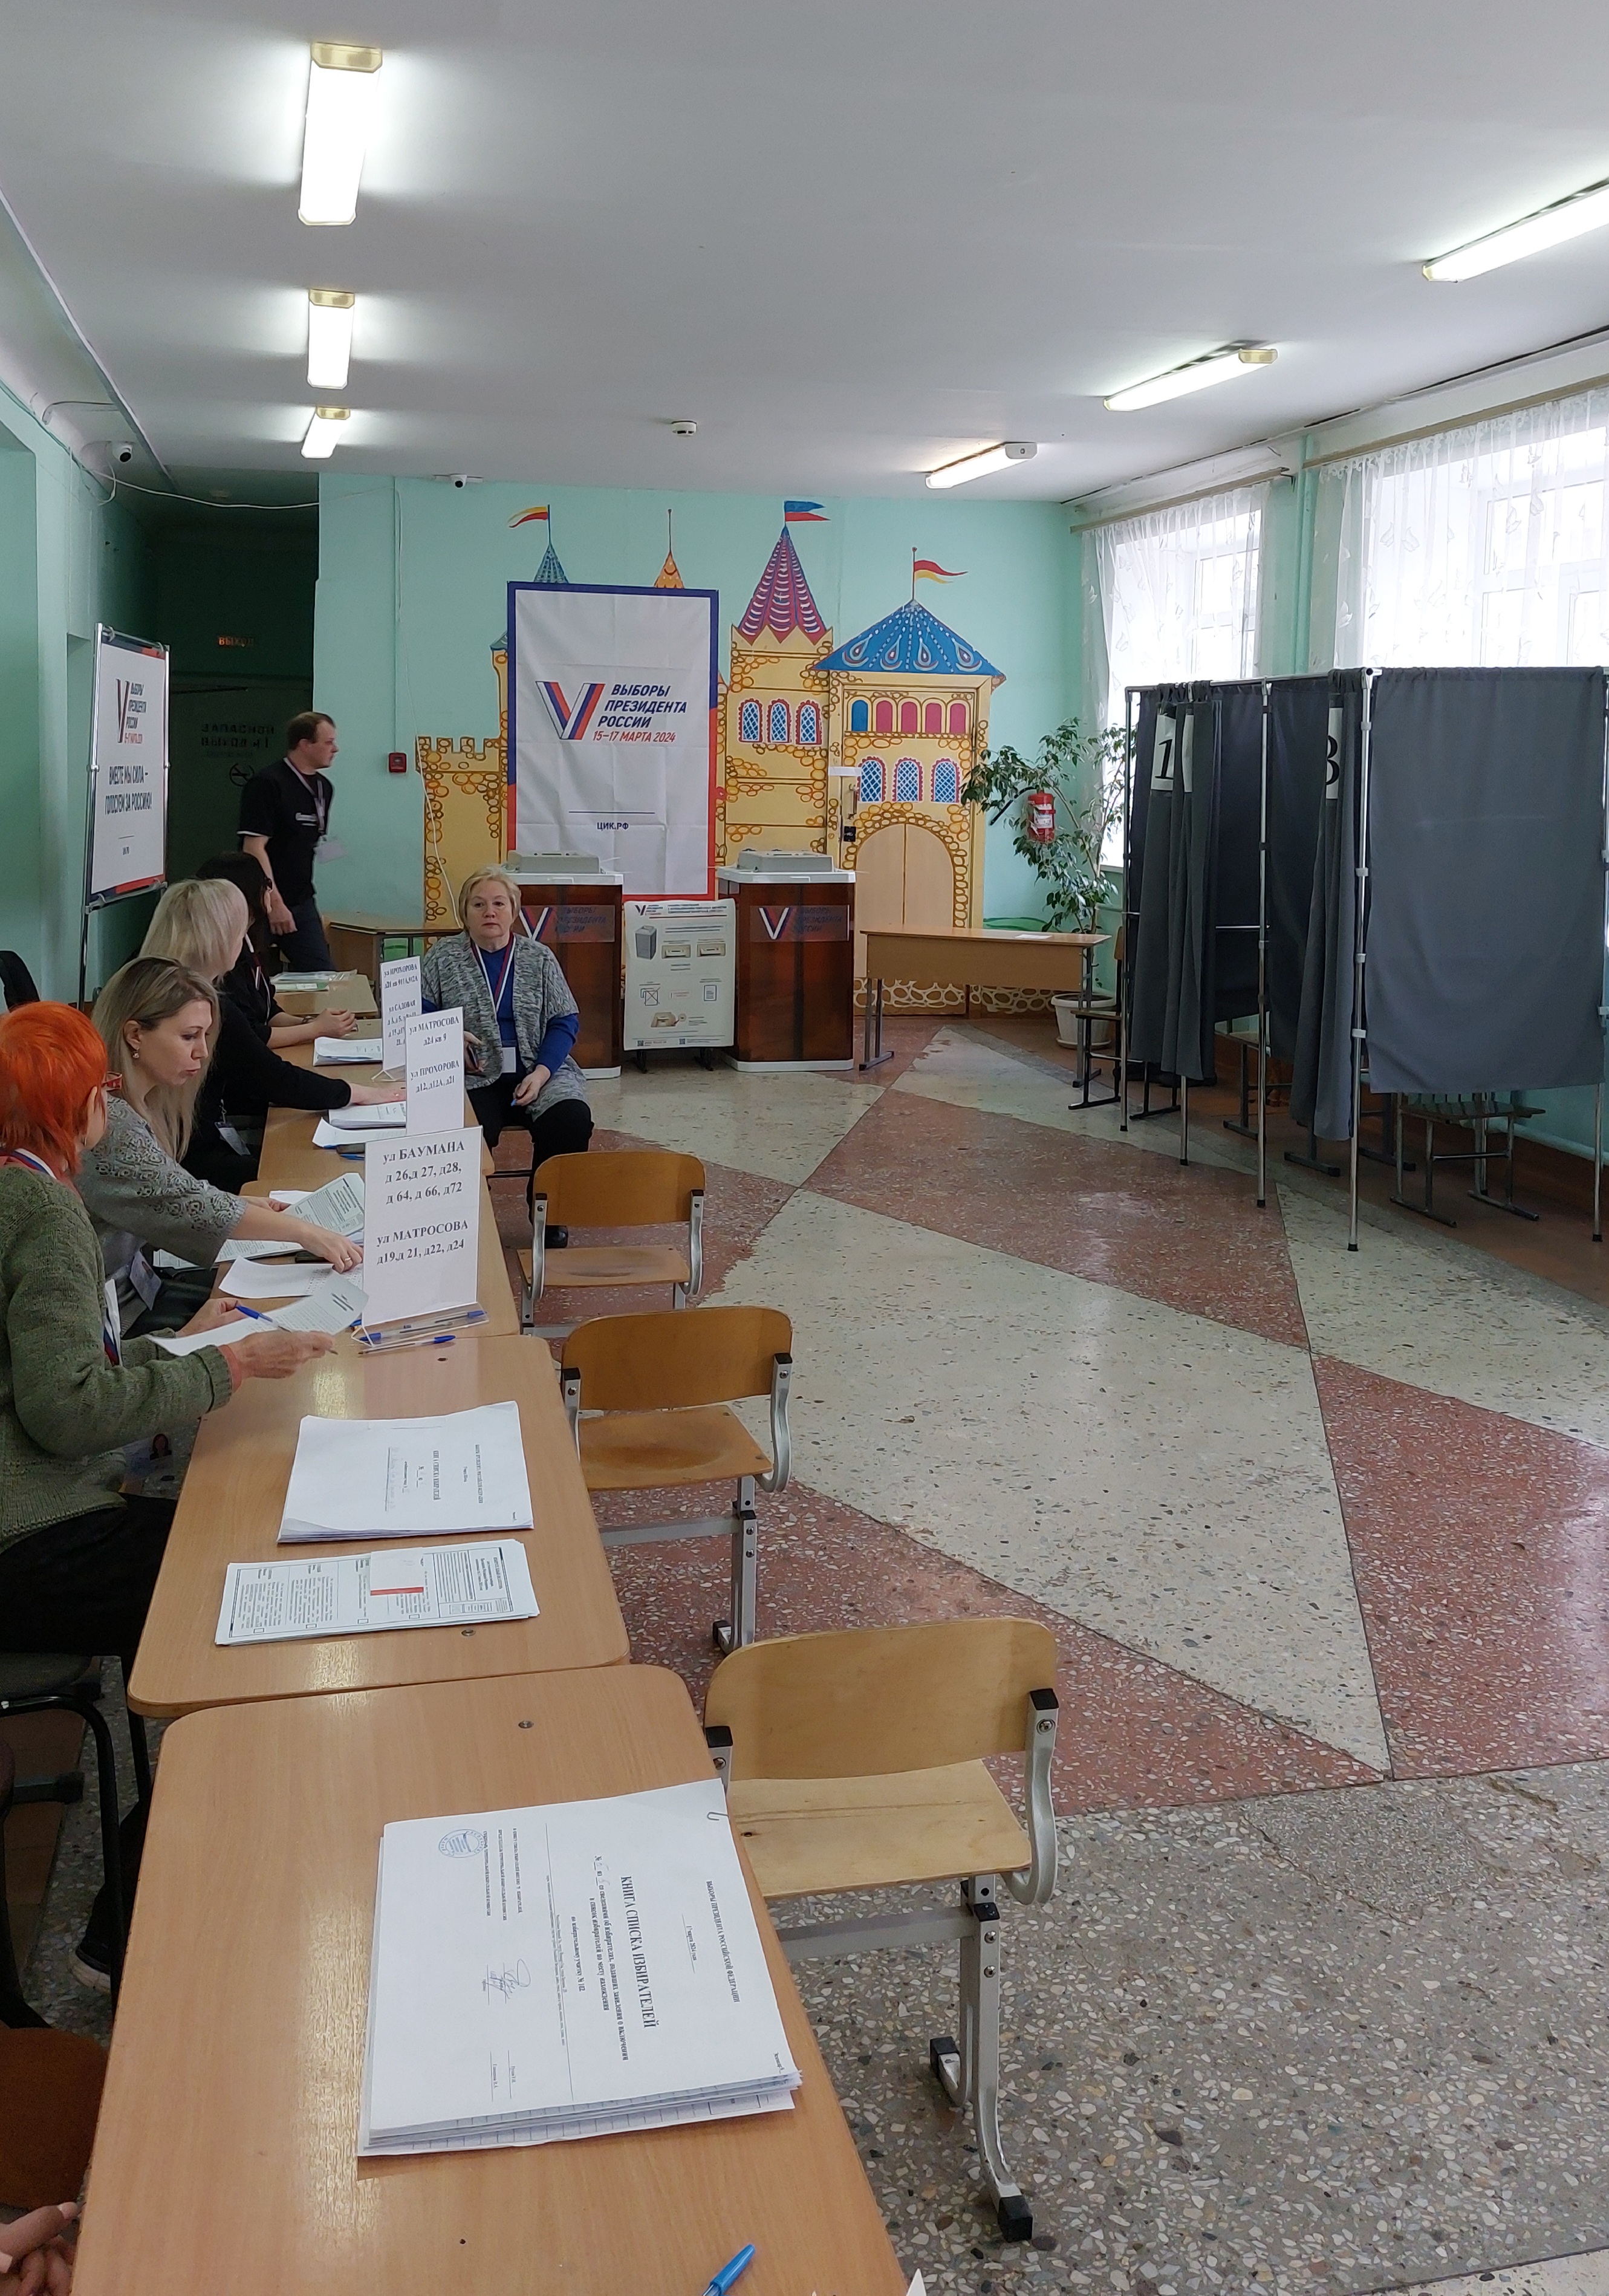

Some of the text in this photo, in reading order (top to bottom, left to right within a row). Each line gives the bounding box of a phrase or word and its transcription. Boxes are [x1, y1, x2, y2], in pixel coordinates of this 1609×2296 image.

[611, 684, 671, 697] ВЫБОРЫ
[604, 700, 687, 714] ПРЕЗИДЕНТА
[597, 715, 652, 728] РОССИИ
[619, 732, 652, 743] МАРТА
[653, 732, 677, 743] 2024
[1155, 739, 1174, 780] 1
[109, 766, 124, 785] ВМЕСТЕ
[124, 765, 131, 784] МЫ
[132, 765, 144, 784] СИЛА
[597, 822, 629, 831] ЦИК.РФ
[418, 1016, 459, 1031] МАТРОСОВА
[411, 1060, 460, 1081] ул ПРОХОРОВА
[383, 1140, 464, 1165] ул БАУМАНА
[385, 1174, 392, 1183] д
[386, 1182, 462, 1205] д 64, д 66, д72
[376, 1220, 468, 1247] ул МАТРОСОВА
[446, 1238, 464, 1251] д24
[706, 1881, 740, 2002] ВЫБОРЫ ПРЕЗИДЕНТА РОССИЙСКОЙ ФЕДЕРАЦИИ
[620, 1876, 660, 2028] КНИГА СПИСКА ИЗБИРАТЕЛЕЙ
